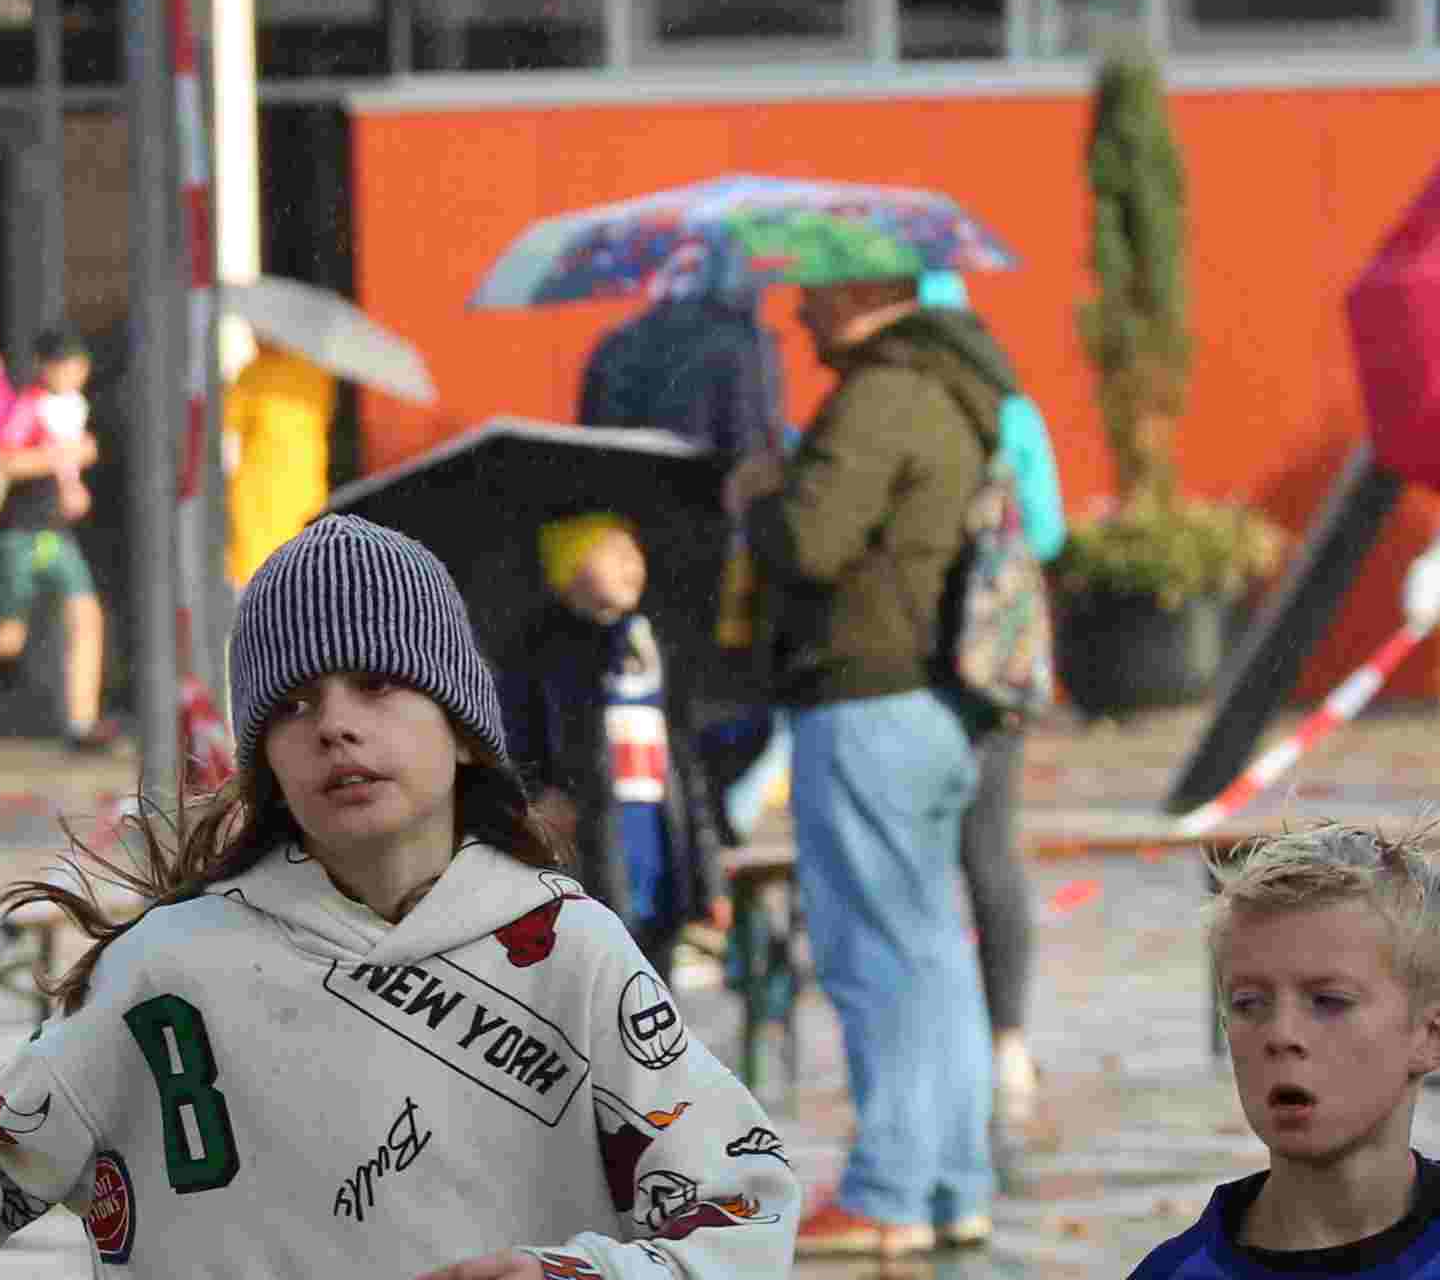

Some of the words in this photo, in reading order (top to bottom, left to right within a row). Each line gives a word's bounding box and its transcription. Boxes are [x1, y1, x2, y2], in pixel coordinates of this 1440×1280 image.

[122, 993, 240, 1194] B
[349, 964, 466, 1030] NEW
[457, 1004, 569, 1094] YORK
